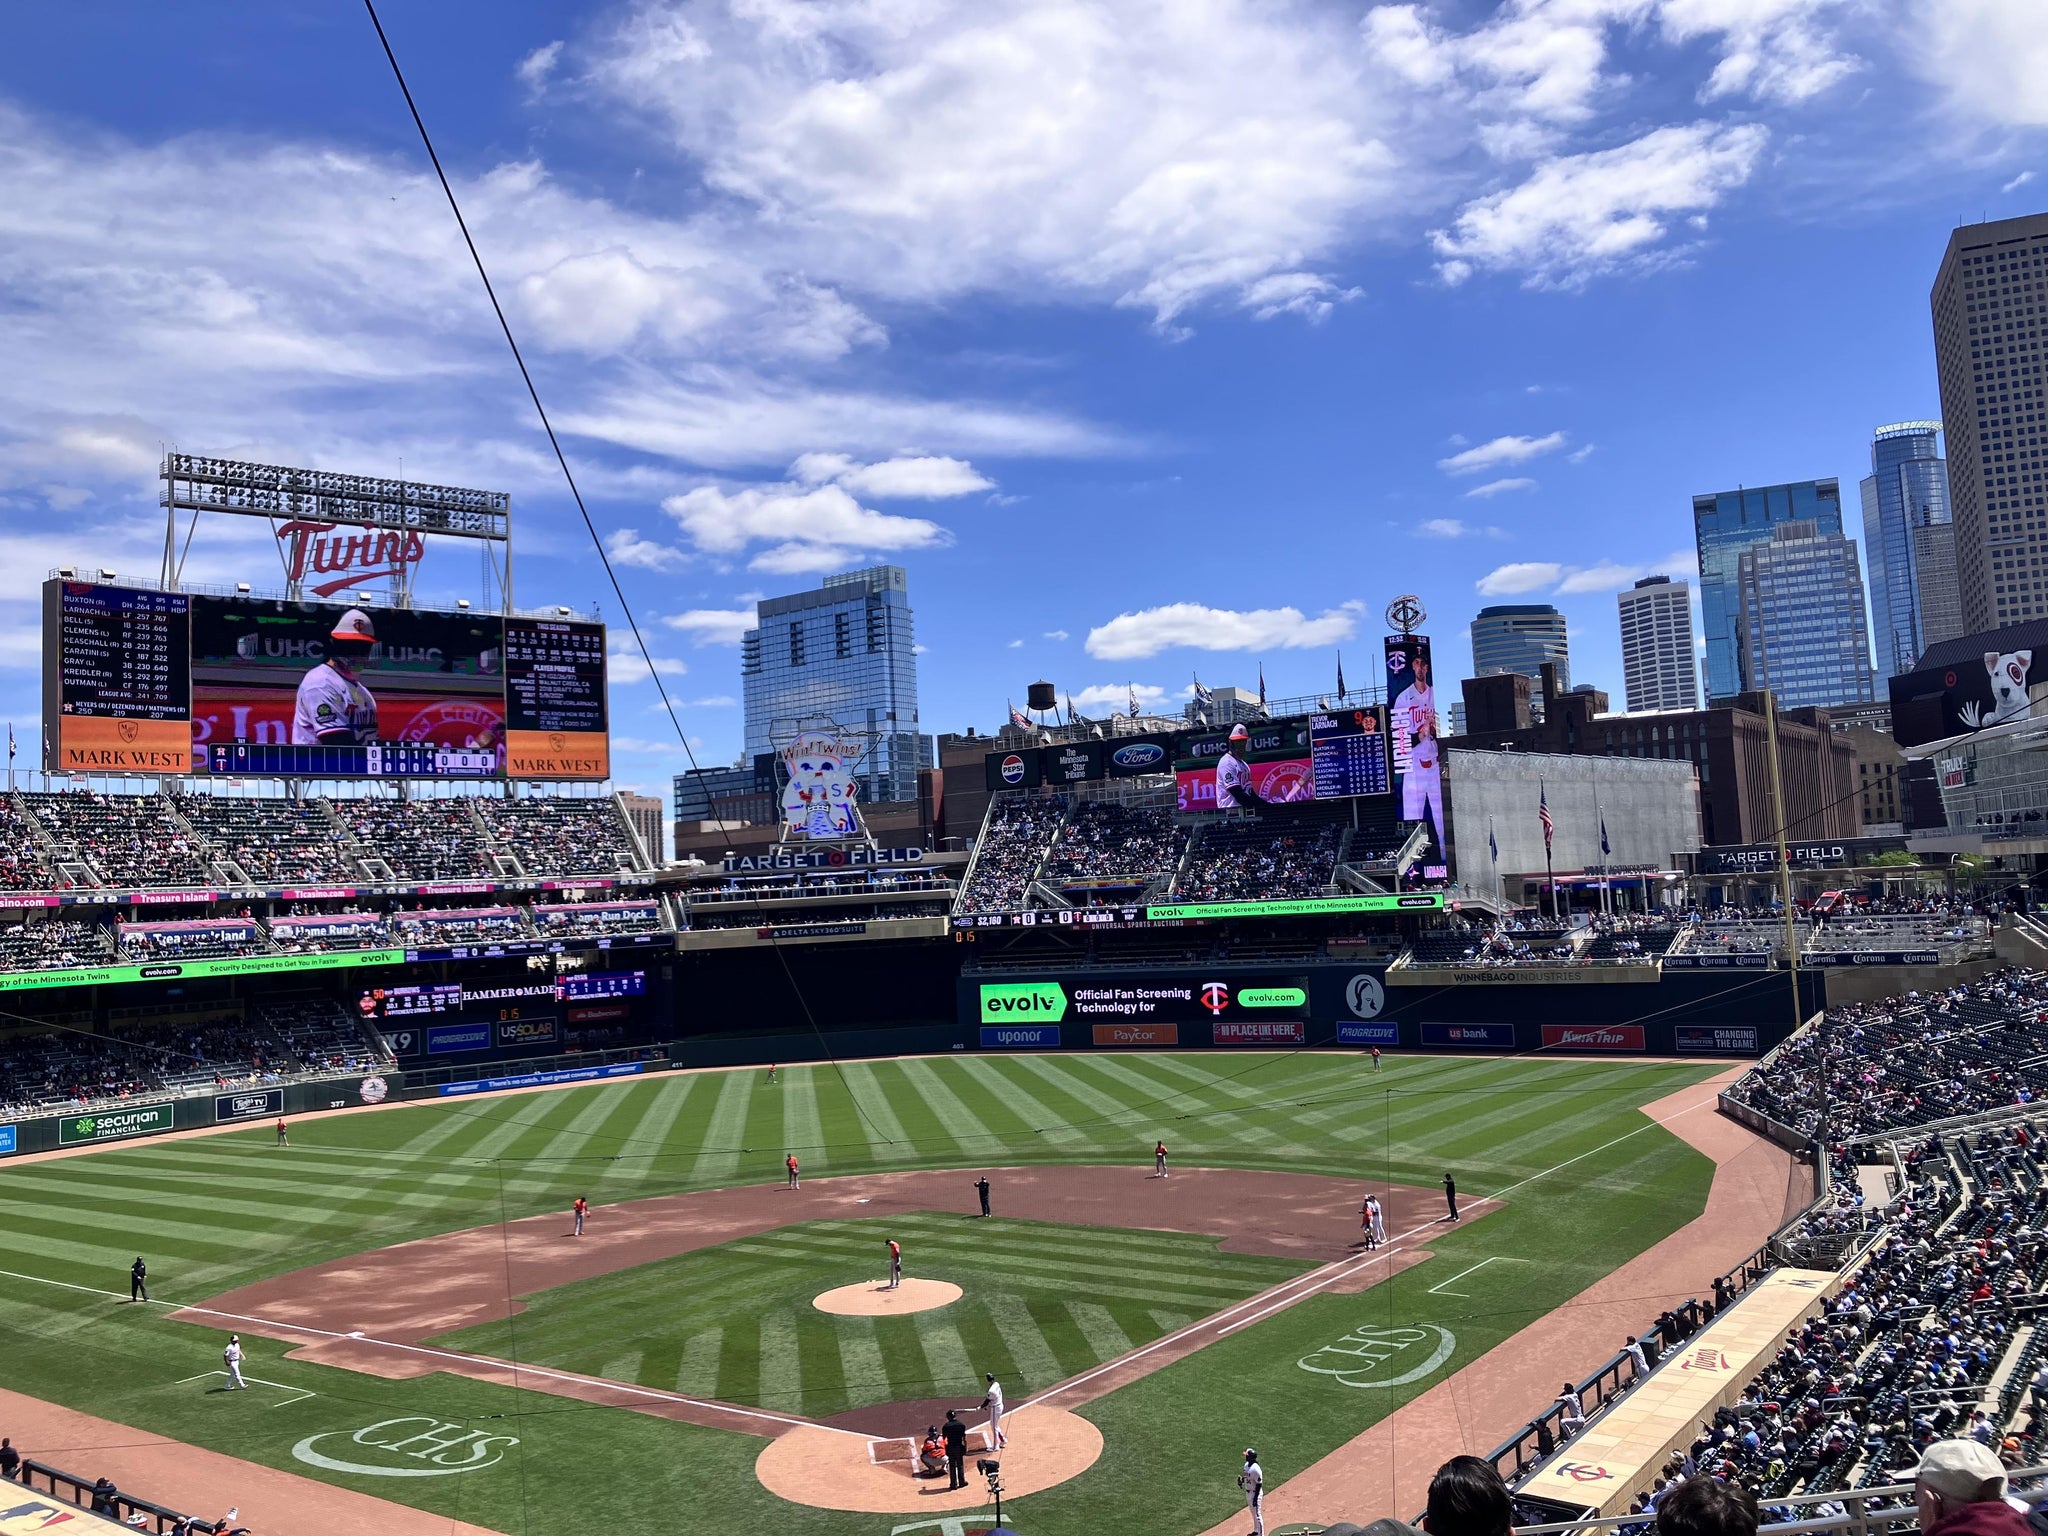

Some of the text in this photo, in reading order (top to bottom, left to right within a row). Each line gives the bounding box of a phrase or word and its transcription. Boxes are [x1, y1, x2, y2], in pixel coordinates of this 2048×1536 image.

[277, 521, 424, 583] Twins
[64, 596, 95, 605] BUXTON
[64, 606, 100, 615] LARNACH
[64, 627, 99, 635] CLEMENS
[64, 638, 108, 647] KEASCHALL
[264, 638, 324, 658] UHC
[64, 648, 99, 656] CARATINI
[389, 646, 443, 661] UHC
[64, 668, 101, 677] KREIDLER
[534, 664, 575, 673] PLAYER PROFILE
[149, 705, 176, 713] MATTHEWS
[1354, 711, 1363, 725] 9
[1312, 720, 1337, 729] LARNACH
[1254, 736, 1280, 749] UHC
[783, 739, 861, 759] Win! Twins!
[1203, 743, 1227, 754] UHC
[70, 749, 184, 766] MARK WEST
[1060, 755, 1088, 764] Minnesota
[1122, 748, 1153, 763] Ford
[513, 759, 601, 772] MARK WEST
[1942, 756, 1963, 773] TRULY
[1065, 771, 1085, 779] Tribune
[831, 784, 841, 797] S
[725, 847, 923, 871] TARGET FIELD
[1718, 847, 1843, 863] TARGET FIELD
[426, 884, 487, 894] Treasure Island
[141, 893, 209, 903] Treasure Island
[1402, 898, 1432, 906] evolv.com
[1153, 908, 1184, 917] evolv
[1196, 906, 1218, 914] Official
[1220, 906, 1231, 914] Fan
[1233, 905, 1266, 914] Screening
[1268, 903, 1304, 912] Technology
[1327, 901, 1362, 909] Minnesota
[1092, 922, 1125, 930] UNIVERSAL
[1154, 919, 1183, 927] AUCTIONS
[781, 926, 808, 936] DELTA
[361, 953, 392, 963] evolv
[1664, 957, 1692, 967] Corona
[1700, 957, 1728, 967] Corona
[1736, 955, 1765, 966] Corona
[1805, 954, 1836, 966] Corona
[1853, 954, 1885, 964] Corona
[1903, 952, 1937, 963] Corona
[210, 964, 240, 972] Security
[242, 961, 274, 971] Designed
[285, 959, 296, 967] Get
[145, 968, 177, 976] evolv.com
[1454, 972, 1582, 982] WINNEBAGO INDUSTRIES
[40, 974, 84, 984] Minnesota
[87, 972, 110, 980] Twins
[373, 989, 384, 999] 50
[463, 988, 516, 1000] HAMMER
[523, 985, 555, 995] MADE
[1075, 987, 1191, 1001] Official Fan Screening
[1248, 993, 1295, 1002] evolv.com
[987, 993, 1054, 1012] evolv
[1076, 1001, 1155, 1015] Technology for
[1114, 1028, 1155, 1041] Paycor
[1231, 1025, 1257, 1035] PLACE
[1259, 1025, 1271, 1035] LIKE
[1273, 1024, 1295, 1035] HERE
[1340, 1028, 1395, 1038] PROGRESSIVE
[1463, 1028, 1488, 1038] bank
[1714, 1030, 1754, 1039] CHANGING
[432, 1032, 486, 1044] PROGRESSIVE
[998, 1030, 1041, 1042] uponor
[1715, 1039, 1754, 1048] THE GAME
[488, 1078, 510, 1088] There's
[254, 1098, 264, 1106] TV
[97, 1110, 158, 1128] securian
[97, 1125, 141, 1136] FINANCIAL
[1297, 1325, 1427, 1374] CHS
[1681, 1348, 1719, 1372] Twins
[352, 1417, 520, 1465] CHS
